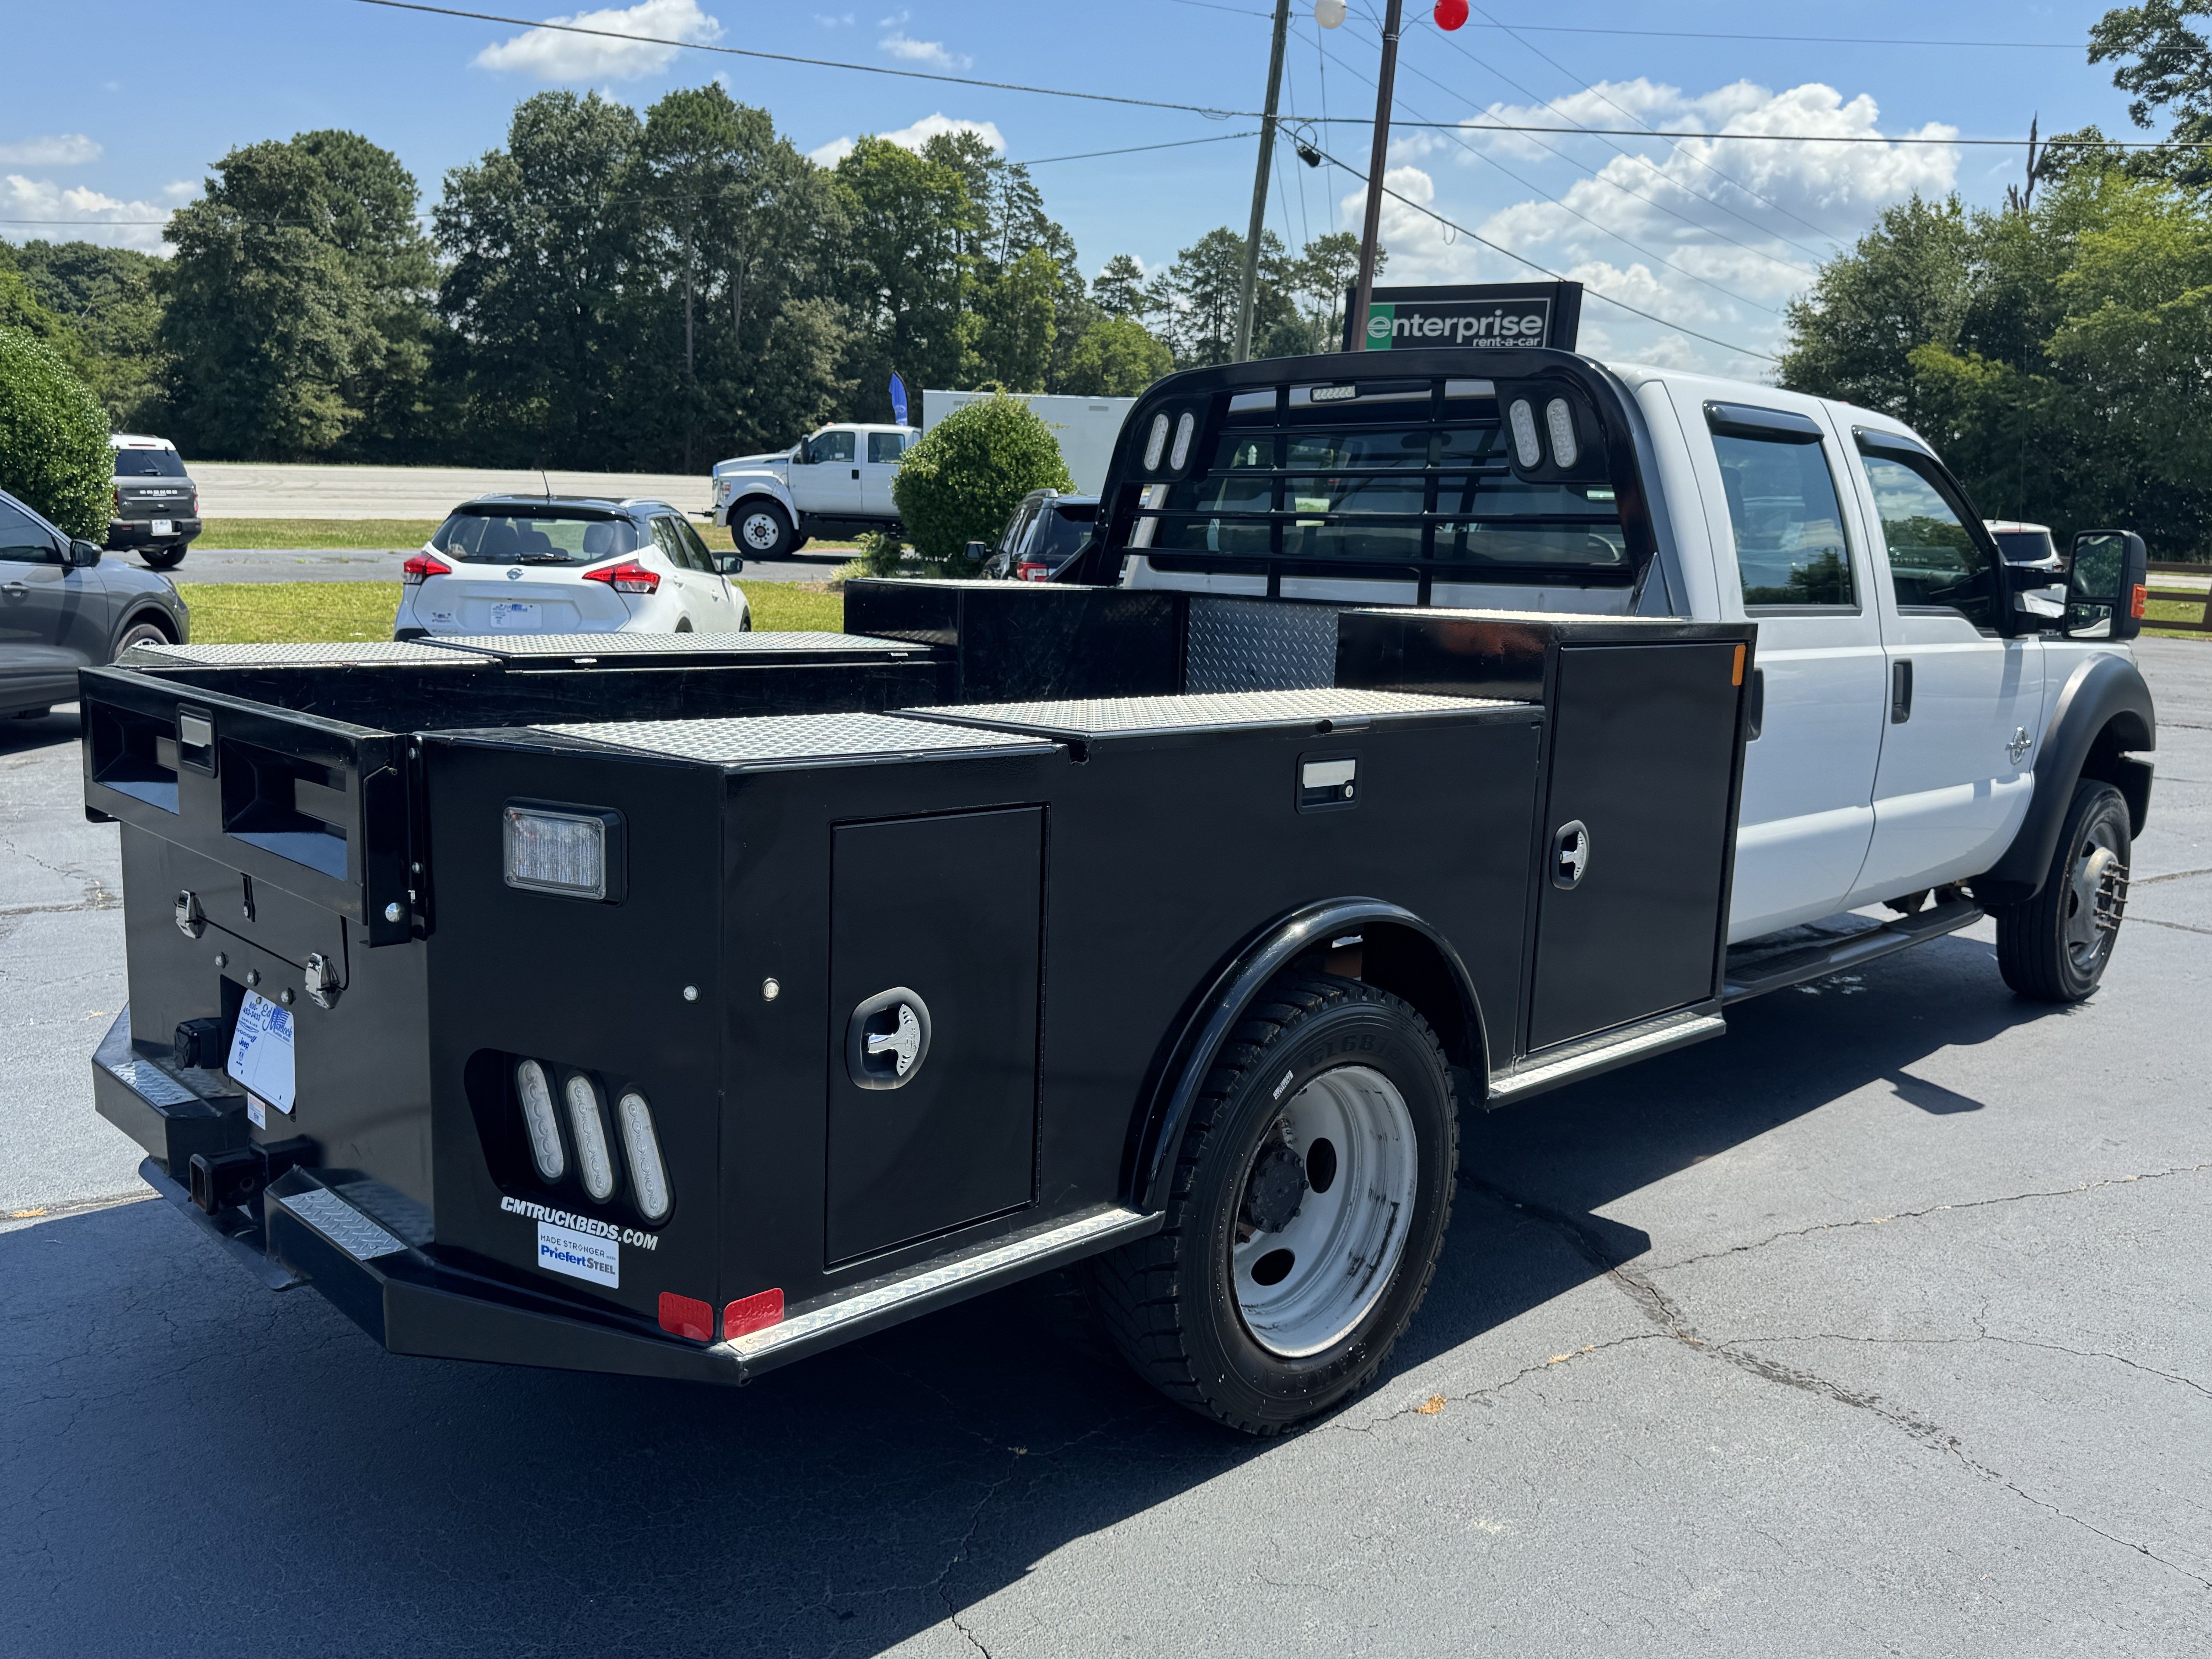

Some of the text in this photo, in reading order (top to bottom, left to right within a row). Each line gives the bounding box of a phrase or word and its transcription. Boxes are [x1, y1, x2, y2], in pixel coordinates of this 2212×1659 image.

[1367, 309, 1544, 343] enterprise
[1473, 337, 1540, 347] rent-a-car
[501, 1196, 658, 1251] CMTRUCKBEDS.COM
[541, 1234, 561, 1246] MADE
[563, 1240, 605, 1258] STRONGER
